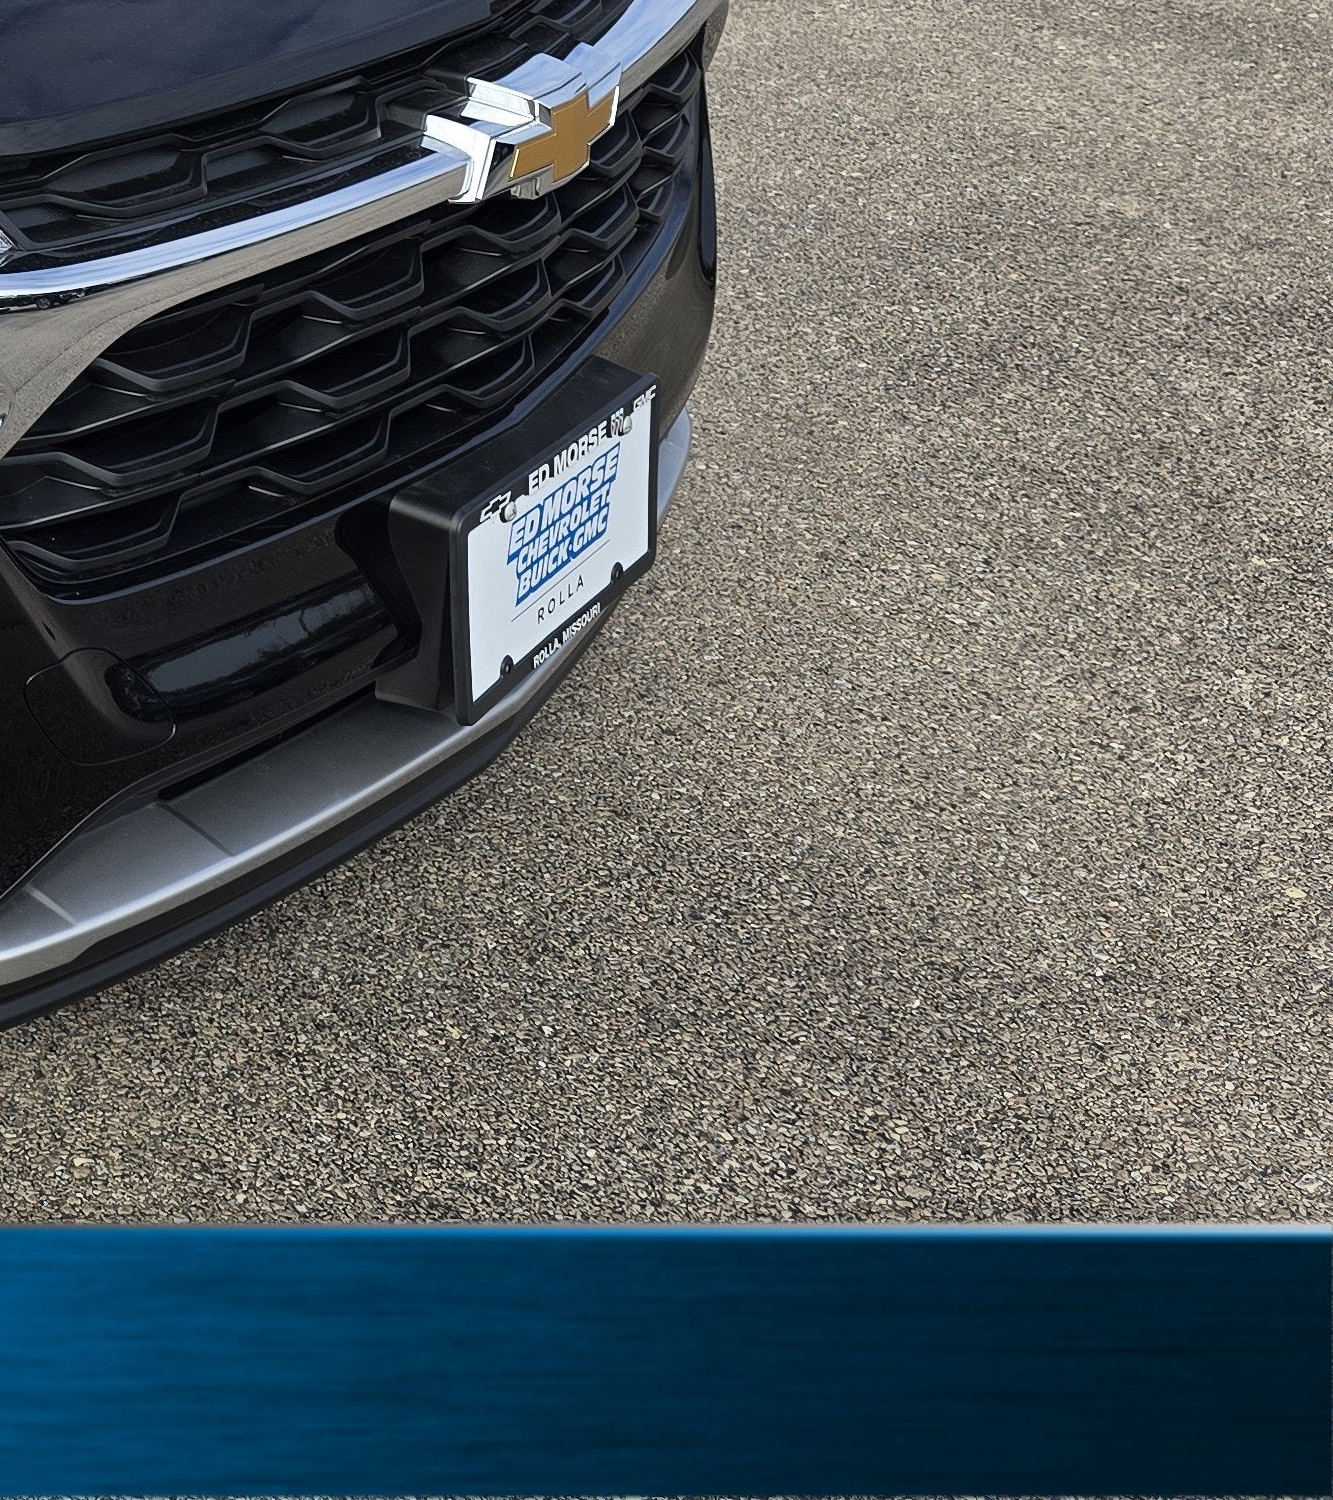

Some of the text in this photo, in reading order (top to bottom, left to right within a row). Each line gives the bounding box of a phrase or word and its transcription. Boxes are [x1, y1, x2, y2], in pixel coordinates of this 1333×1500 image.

[633, 384, 657, 412] GMC
[528, 420, 608, 496] ED MORSE
[508, 443, 620, 558] ED MORSE
[517, 481, 611, 574] CHEVROLET
[537, 574, 584, 625] ROLLA
[562, 601, 601, 644] MISSOURI
